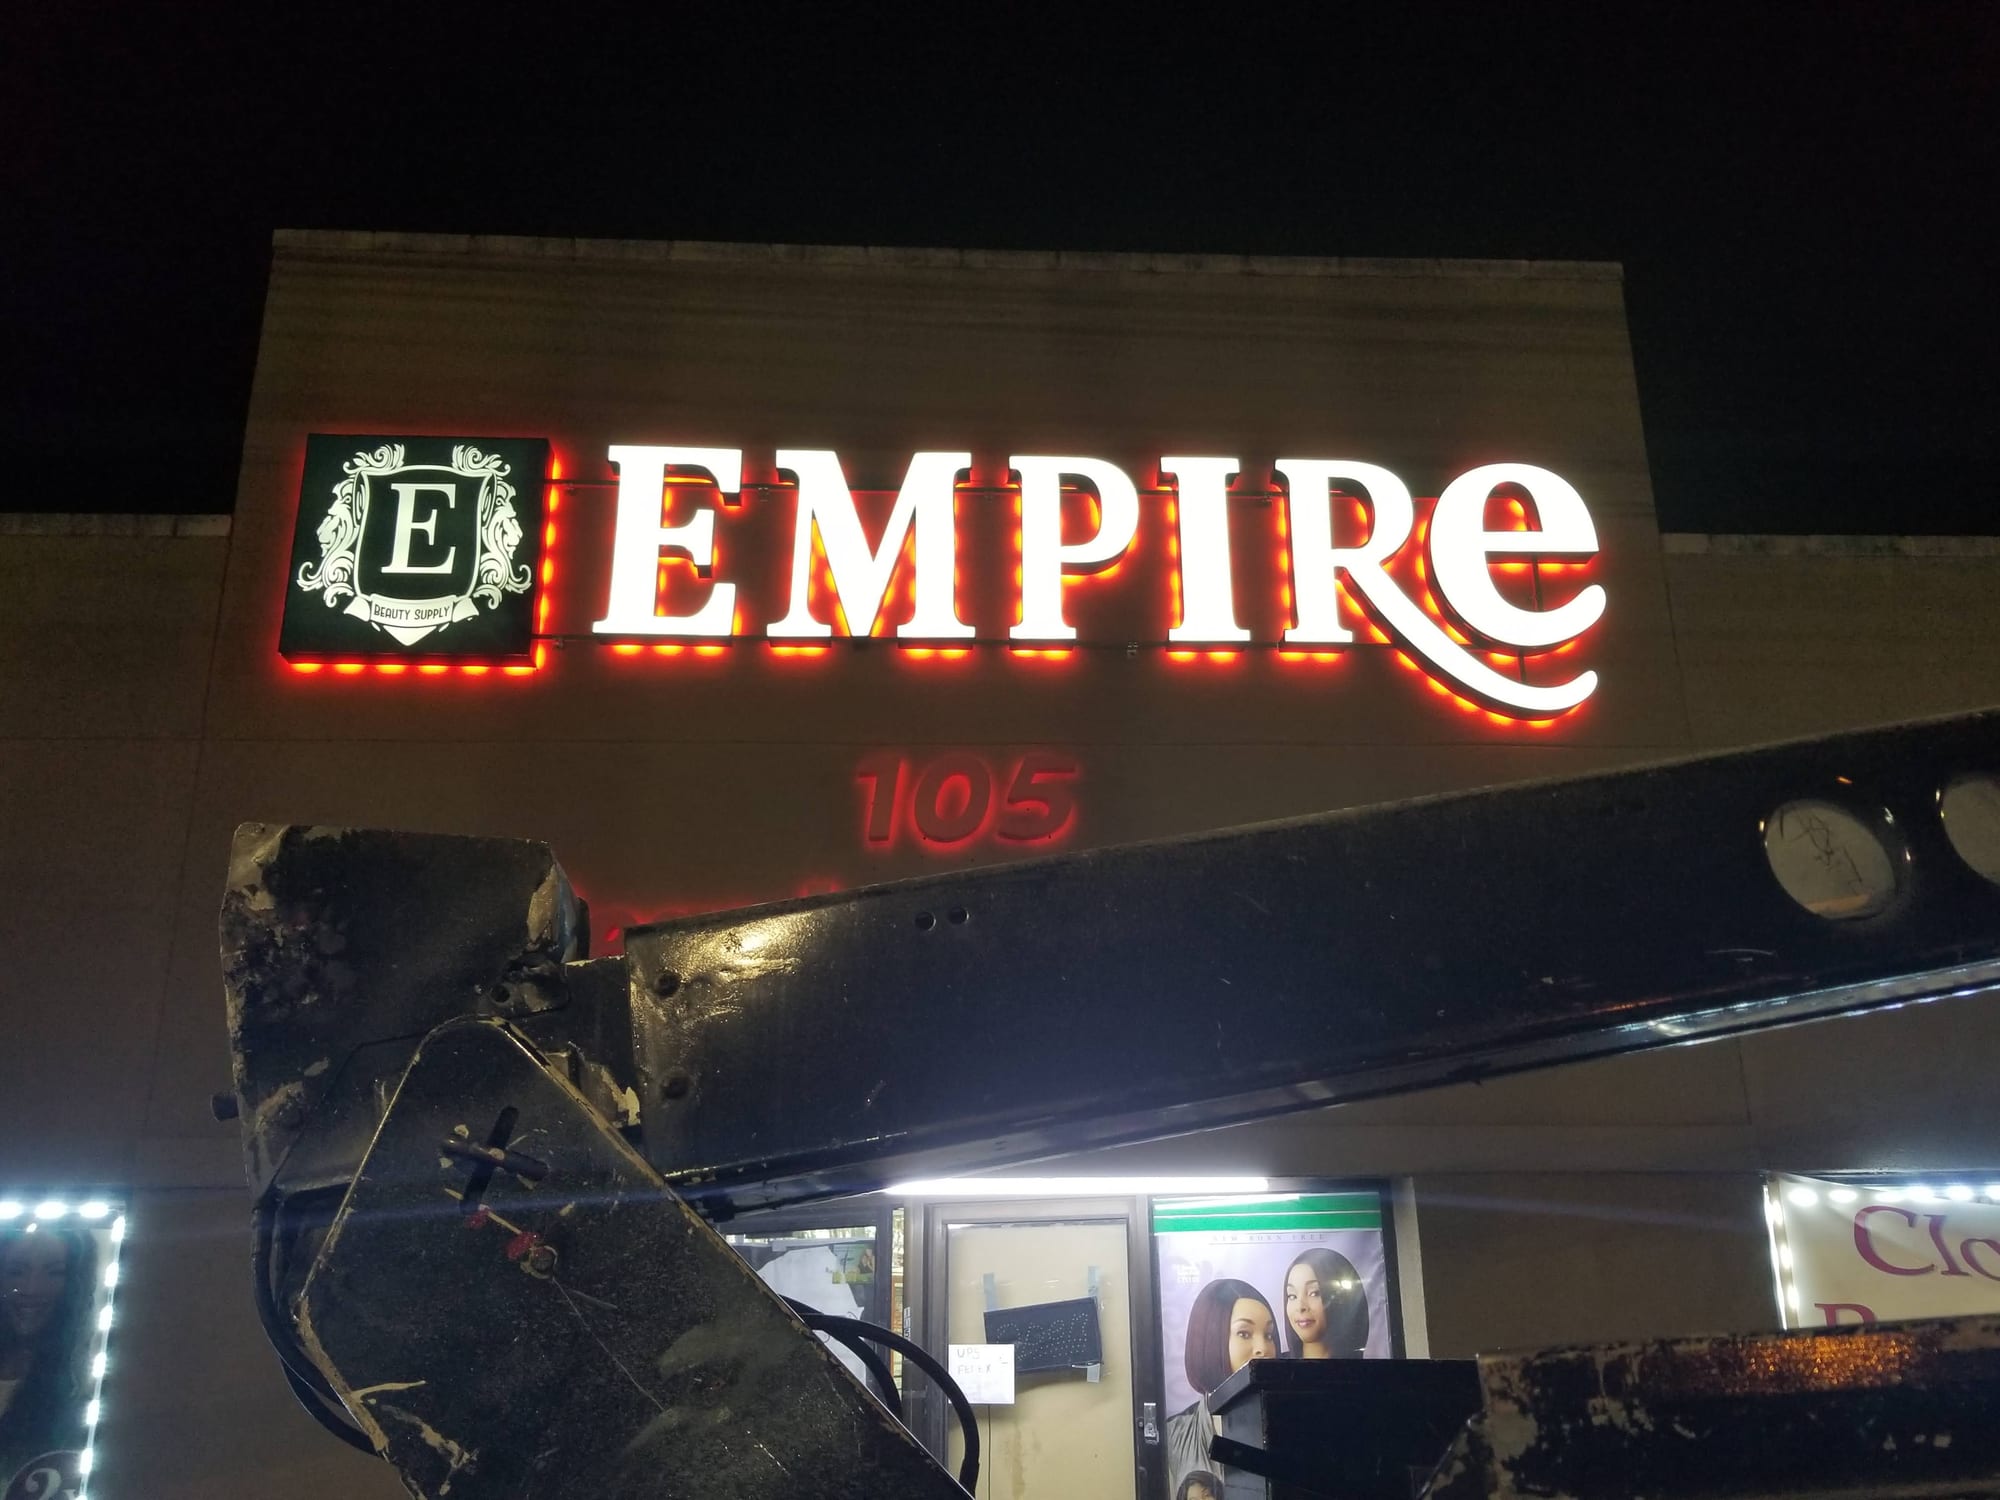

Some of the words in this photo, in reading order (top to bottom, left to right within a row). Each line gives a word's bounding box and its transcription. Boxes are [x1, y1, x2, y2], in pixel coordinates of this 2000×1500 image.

[381, 483, 456, 574] E
[373, 603, 410, 620] BEAUTY
[414, 606, 450, 620] SUPPLY
[856, 753, 1077, 844] 105
[957, 1347, 981, 1359] UPS
